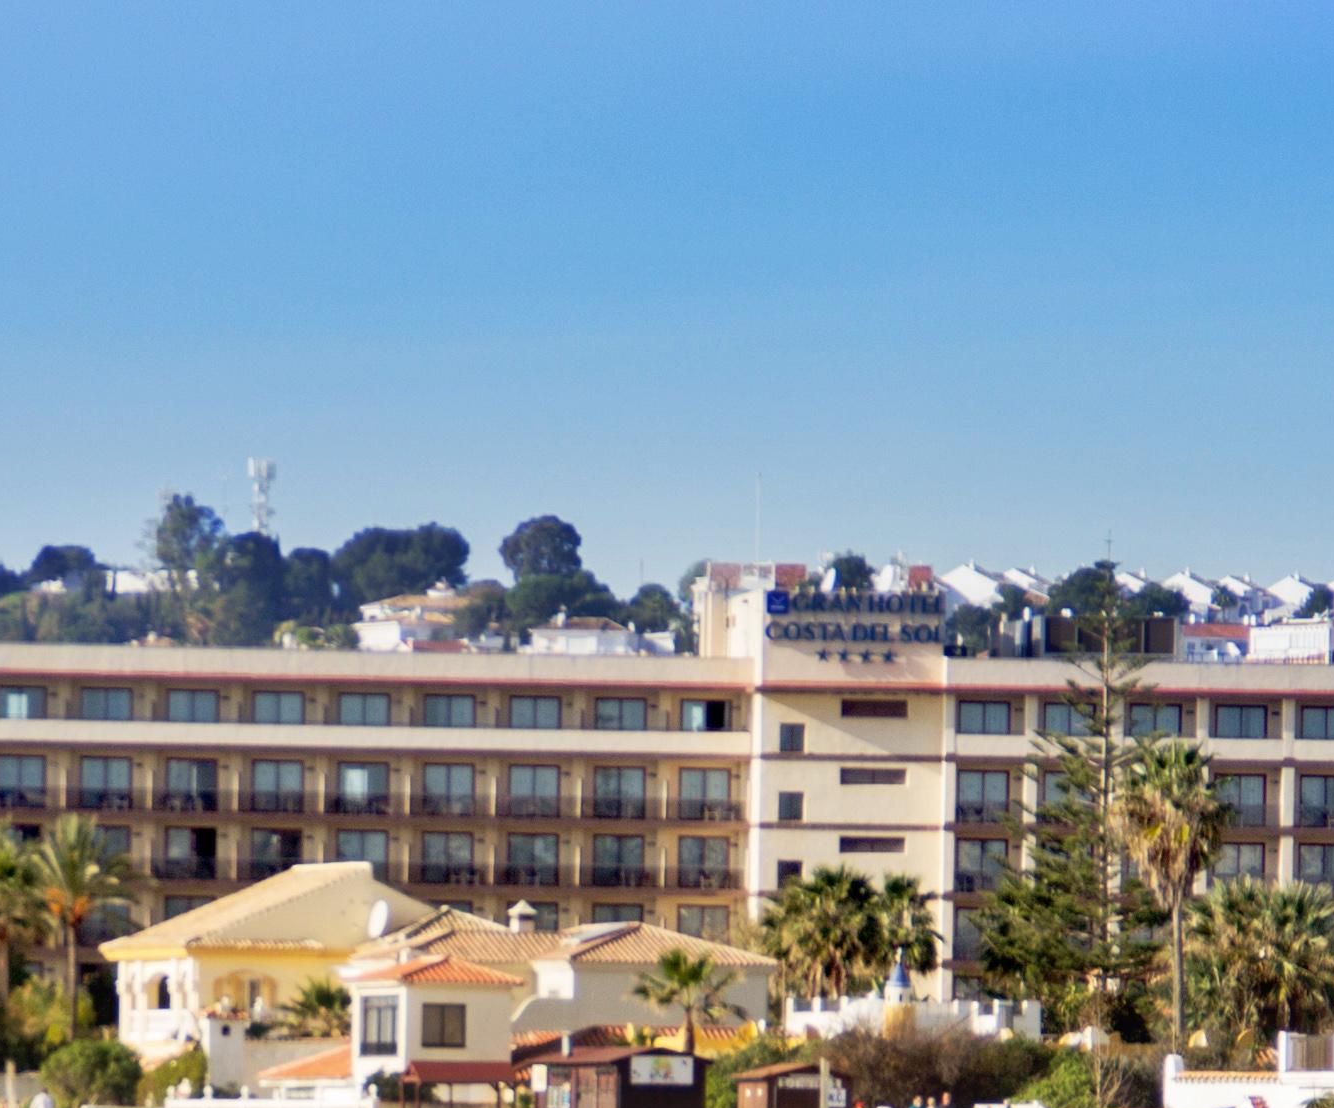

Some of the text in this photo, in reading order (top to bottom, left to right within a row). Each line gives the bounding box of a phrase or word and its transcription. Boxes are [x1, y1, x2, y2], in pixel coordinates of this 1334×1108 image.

[793, 593, 944, 614] GRAN HOTEL
[765, 621, 943, 643] COSTA DEL SOL
